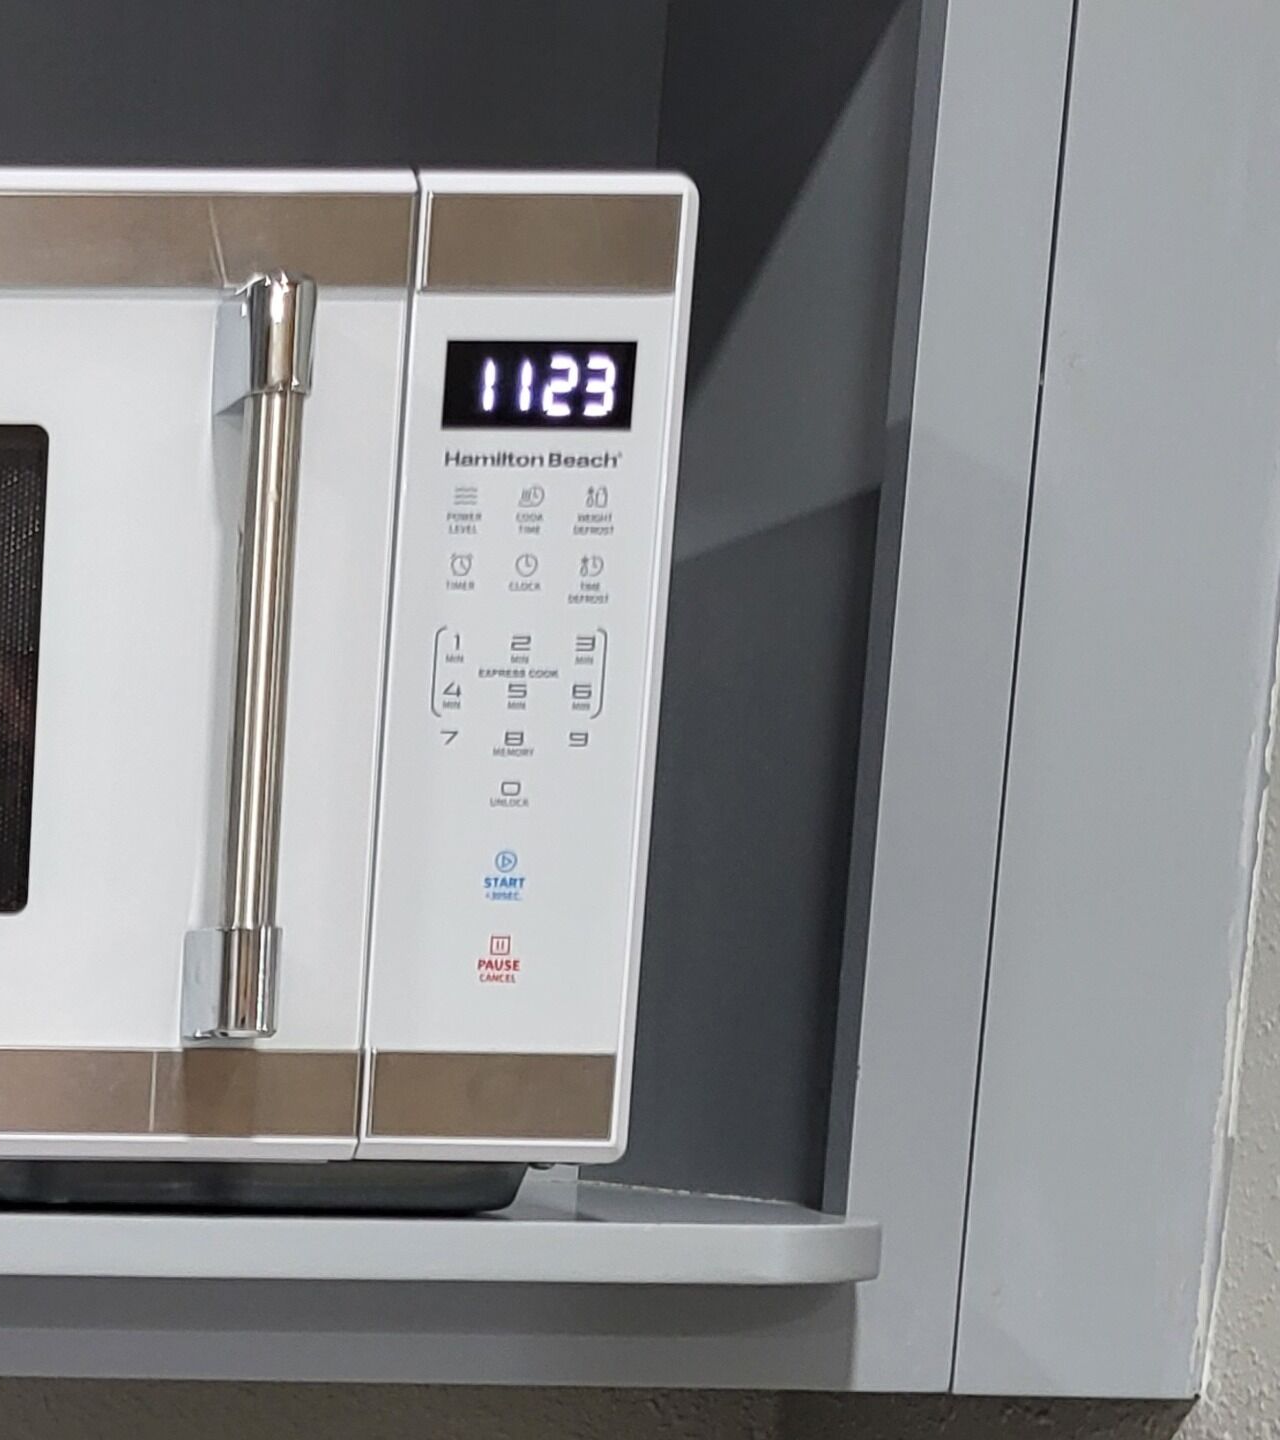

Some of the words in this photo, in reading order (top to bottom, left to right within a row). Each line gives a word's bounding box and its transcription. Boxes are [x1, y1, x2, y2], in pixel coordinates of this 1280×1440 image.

[482, 354, 616, 416] 1123
[444, 451, 544, 468] Hamilton
[548, 452, 618, 468] Beach
[446, 512, 482, 522] POWER
[448, 525, 477, 535] LEVEL
[518, 525, 541, 535] TIME
[573, 526, 614, 535] DEFROST
[446, 581, 475, 590] TIMER
[508, 582, 541, 591] CLOCK
[568, 594, 609, 604] DEFROST
[454, 633, 461, 650] 1
[511, 635, 531, 651] 2
[575, 635, 596, 652] 3
[445, 654, 464, 663] MIN
[511, 655, 529, 664] MIN
[575, 656, 593, 665] MIN
[478, 669, 525, 678] EXPRESS
[528, 670, 559, 678] COOK
[443, 682, 461, 698] 4
[507, 683, 527, 699] 5
[572, 684, 592, 700] 6
[440, 730, 459, 746] 7
[504, 731, 524, 746] 8
[568, 732, 589, 747] 9
[493, 748, 534, 757] MEMORY
[501, 781, 521, 796] 0
[490, 798, 529, 807] UNLOCK
[484, 877, 525, 888] START
[477, 960, 520, 971] PAUSE
[479, 974, 516, 983] CANCEL
